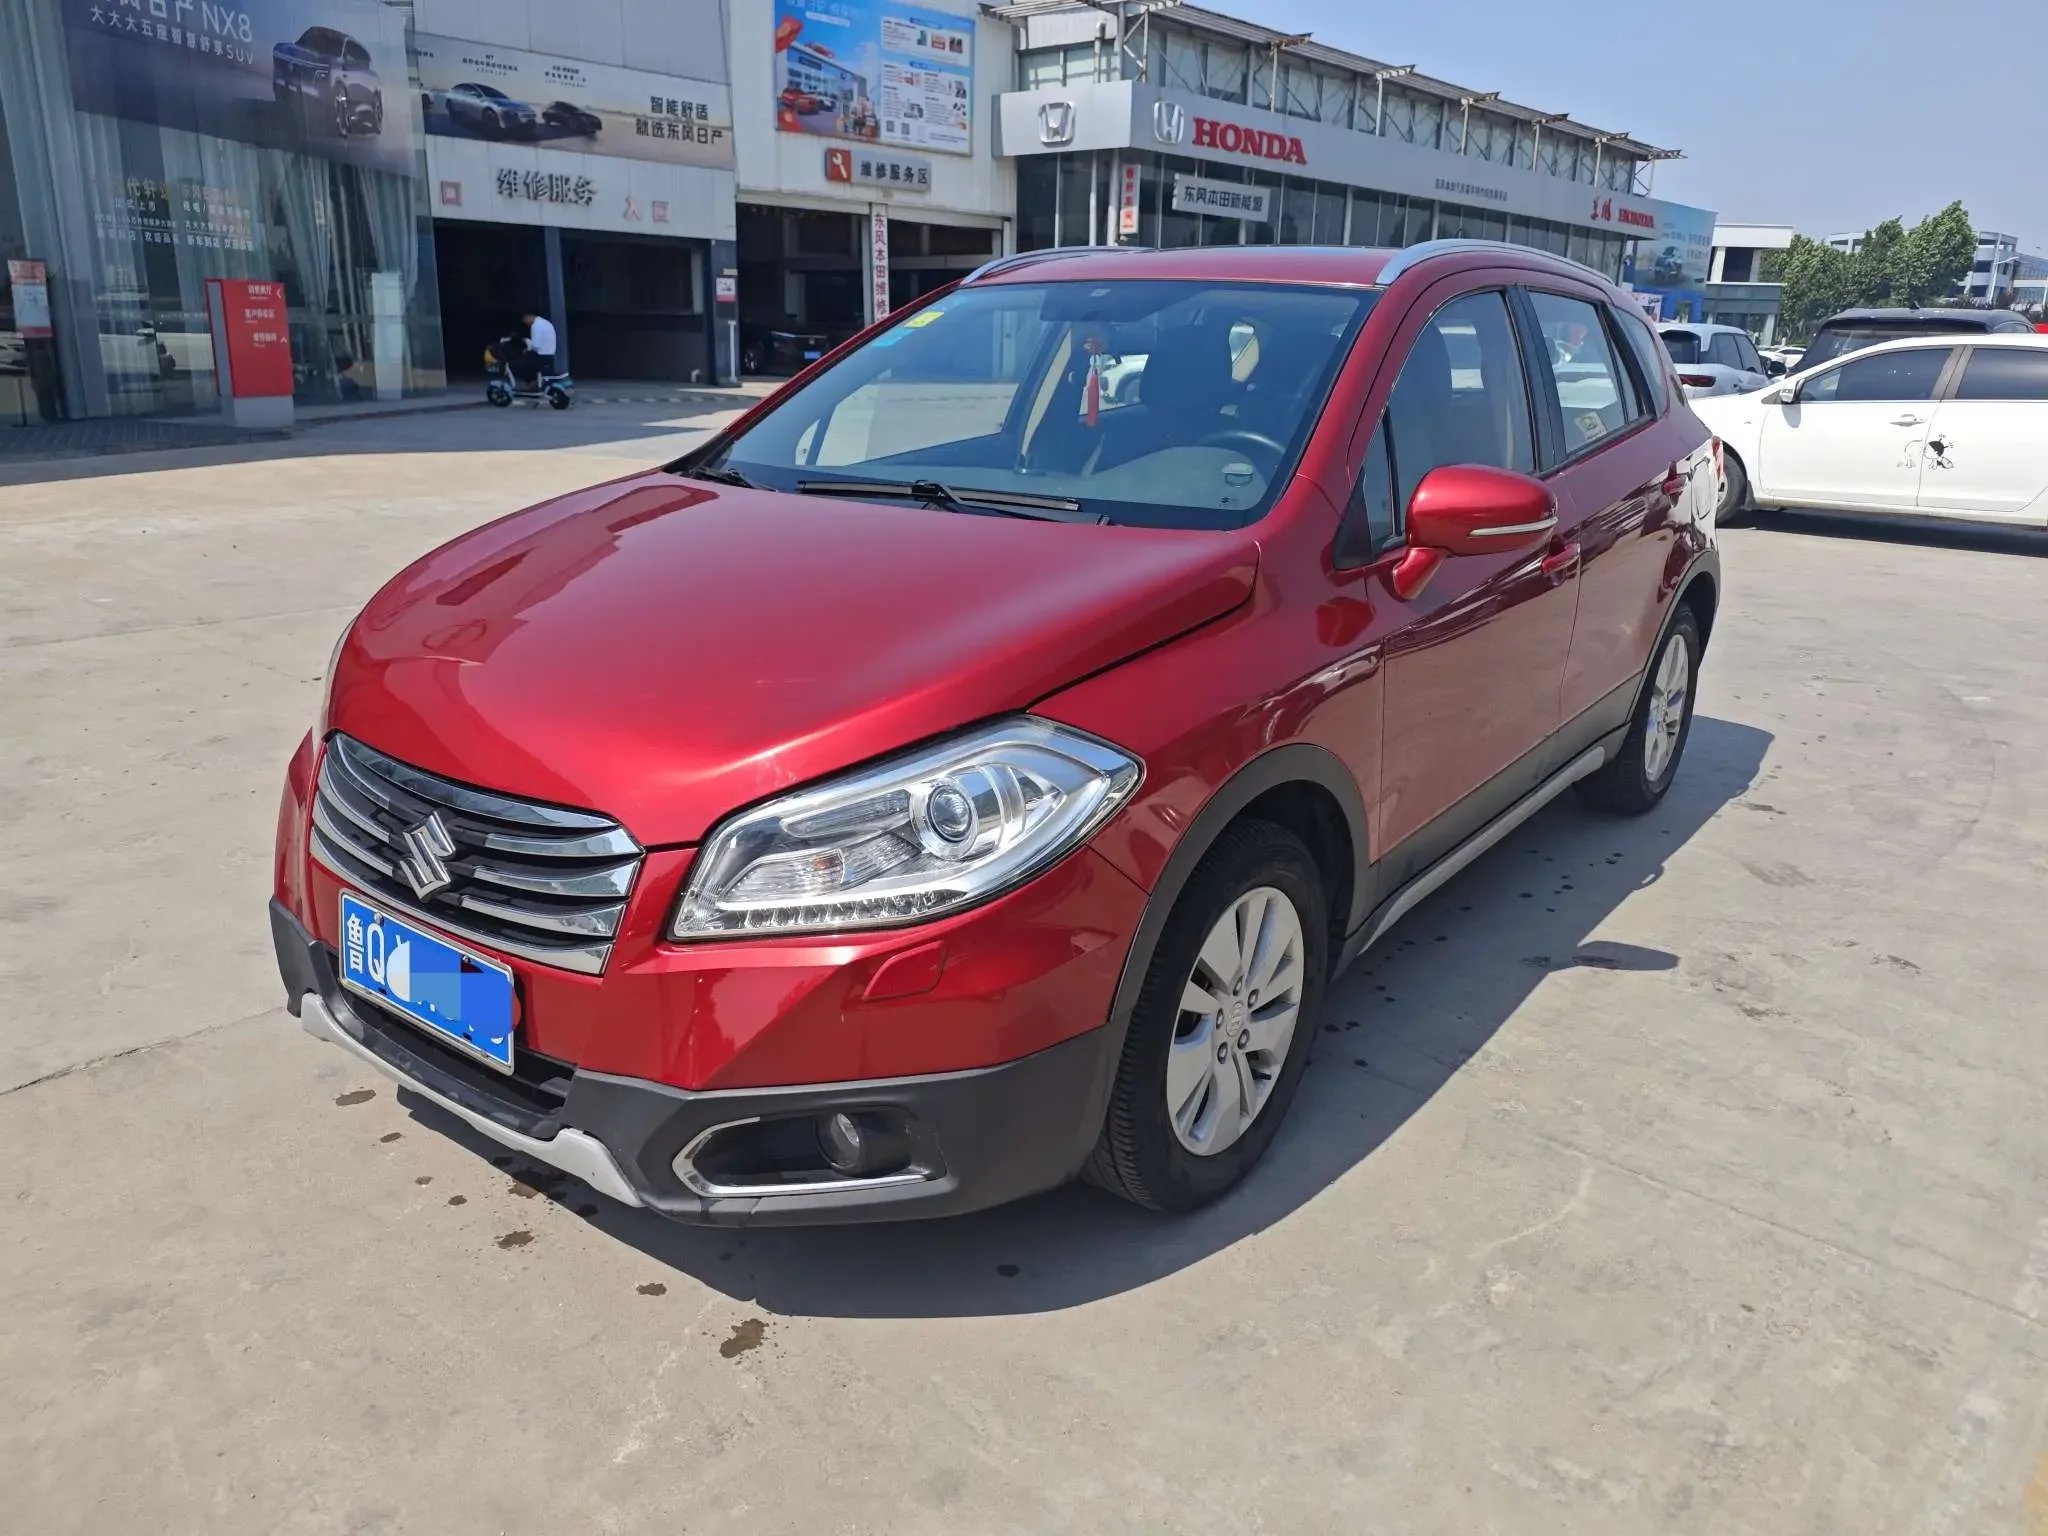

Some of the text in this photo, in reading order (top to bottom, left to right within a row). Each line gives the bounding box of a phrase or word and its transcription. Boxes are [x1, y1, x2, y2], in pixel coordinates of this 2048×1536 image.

[201, 2, 253, 43] NX8
[650, 95, 709, 121] 智能舒适
[636, 118, 724, 145] 就选东风日产
[1192, 116, 1307, 165] HONDA
[497, 168, 597, 206] 维修服务
[860, 160, 928, 184] 维修服务区
[1184, 185, 1264, 213] 东风本田新能源
[874, 211, 887, 321] 东风本田维修
